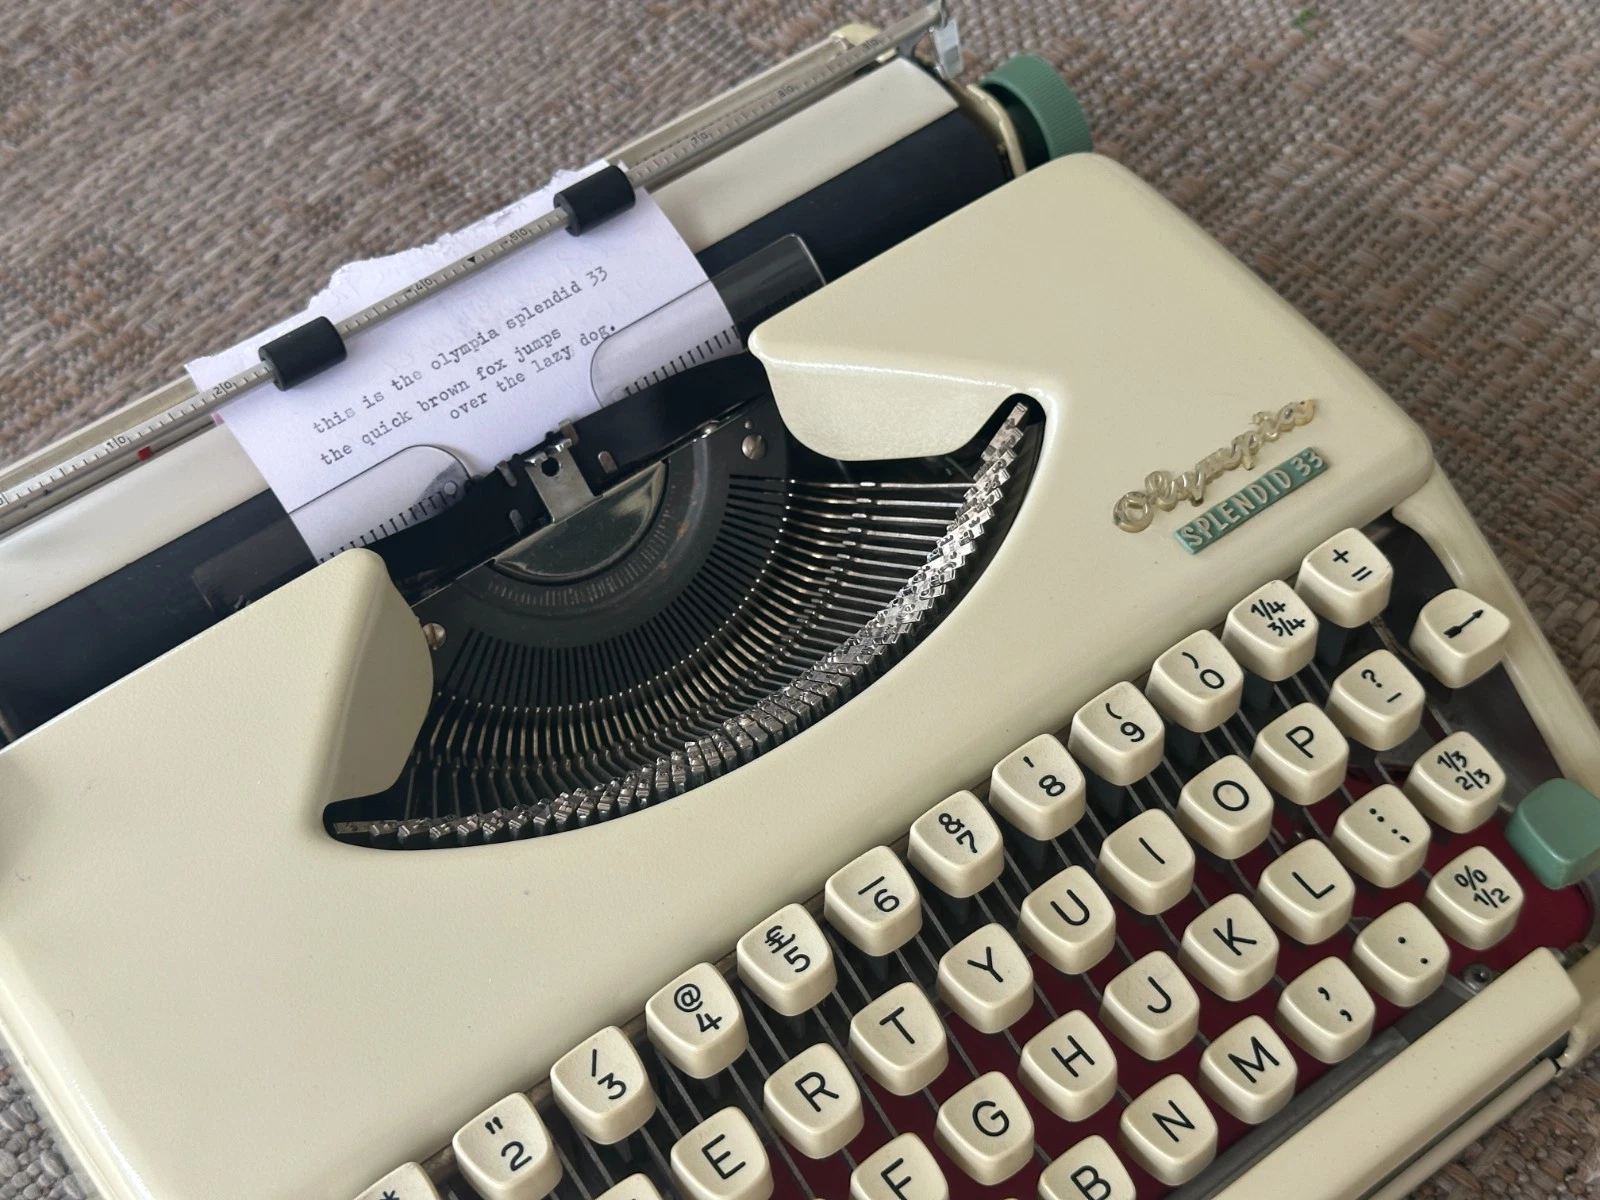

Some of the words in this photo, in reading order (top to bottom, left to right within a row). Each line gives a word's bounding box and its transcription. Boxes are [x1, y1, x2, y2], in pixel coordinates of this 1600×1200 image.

[510, 229, 528, 241] 50
[416, 278, 433, 292] 40
[313, 406, 356, 434] this
[362, 391, 385, 409] is
[391, 370, 422, 391] the
[431, 327, 500, 370] olympia
[506, 280, 582, 330] splendid
[585, 266, 608, 287] 33
[450, 392, 488, 420] over
[496, 372, 526, 393] the
[531, 345, 573, 373] lazy
[579, 325, 616, 347] dog.
[213, 381, 234, 395] 20
[320, 444, 353, 465] the
[361, 410, 413, 446] quick
[417, 379, 470, 412] brown
[476, 358, 508, 381] fox
[515, 328, 562, 363] jumps
[106, 435, 127, 450] 10
[1113, 399, 1316, 533] Olympia
[1182, 469, 1292, 546] SPLENDID
[1290, 450, 1324, 477] 33
[1250, 599, 1286, 619] 1/4
[1267, 616, 1306, 637] 3/4
[1200, 669, 1225, 689] 0
[1361, 669, 1382, 688] ?
[1120, 722, 1145, 742] 9
[1286, 726, 1314, 758] P
[1437, 750, 1468, 772] 1/3
[1039, 775, 1065, 796] 8
[1455, 768, 1491, 792] 2/3
[1213, 780, 1249, 811] O
[939, 812, 965, 835] &
[956, 830, 978, 853] 7
[1139, 838, 1165, 864] I
[1292, 872, 1335, 899] L
[1454, 865, 1488, 891] %
[873, 888, 900, 912] 6
[1050, 889, 1090, 926] U
[1473, 887, 1511, 908] 1/2
[1213, 918, 1257, 956] K
[784, 945, 811, 973] 5
[967, 947, 1003, 982] Y
[673, 983, 704, 1013] @
[1148, 977, 1171, 1013] J
[696, 1012, 722, 1033] 4
[879, 1007, 915, 1044] T
[1051, 1035, 1095, 1077] H
[1228, 1036, 1280, 1083] M
[598, 1071, 627, 1101] 3
[795, 1072, 839, 1112] R
[972, 1101, 1009, 1137] G
[1152, 1100, 1195, 1142] N
[501, 1141, 532, 1171] 2
[702, 1134, 746, 1180] E
[881, 1158, 911, 1200] F
[1070, 1166, 1111, 1200] B
